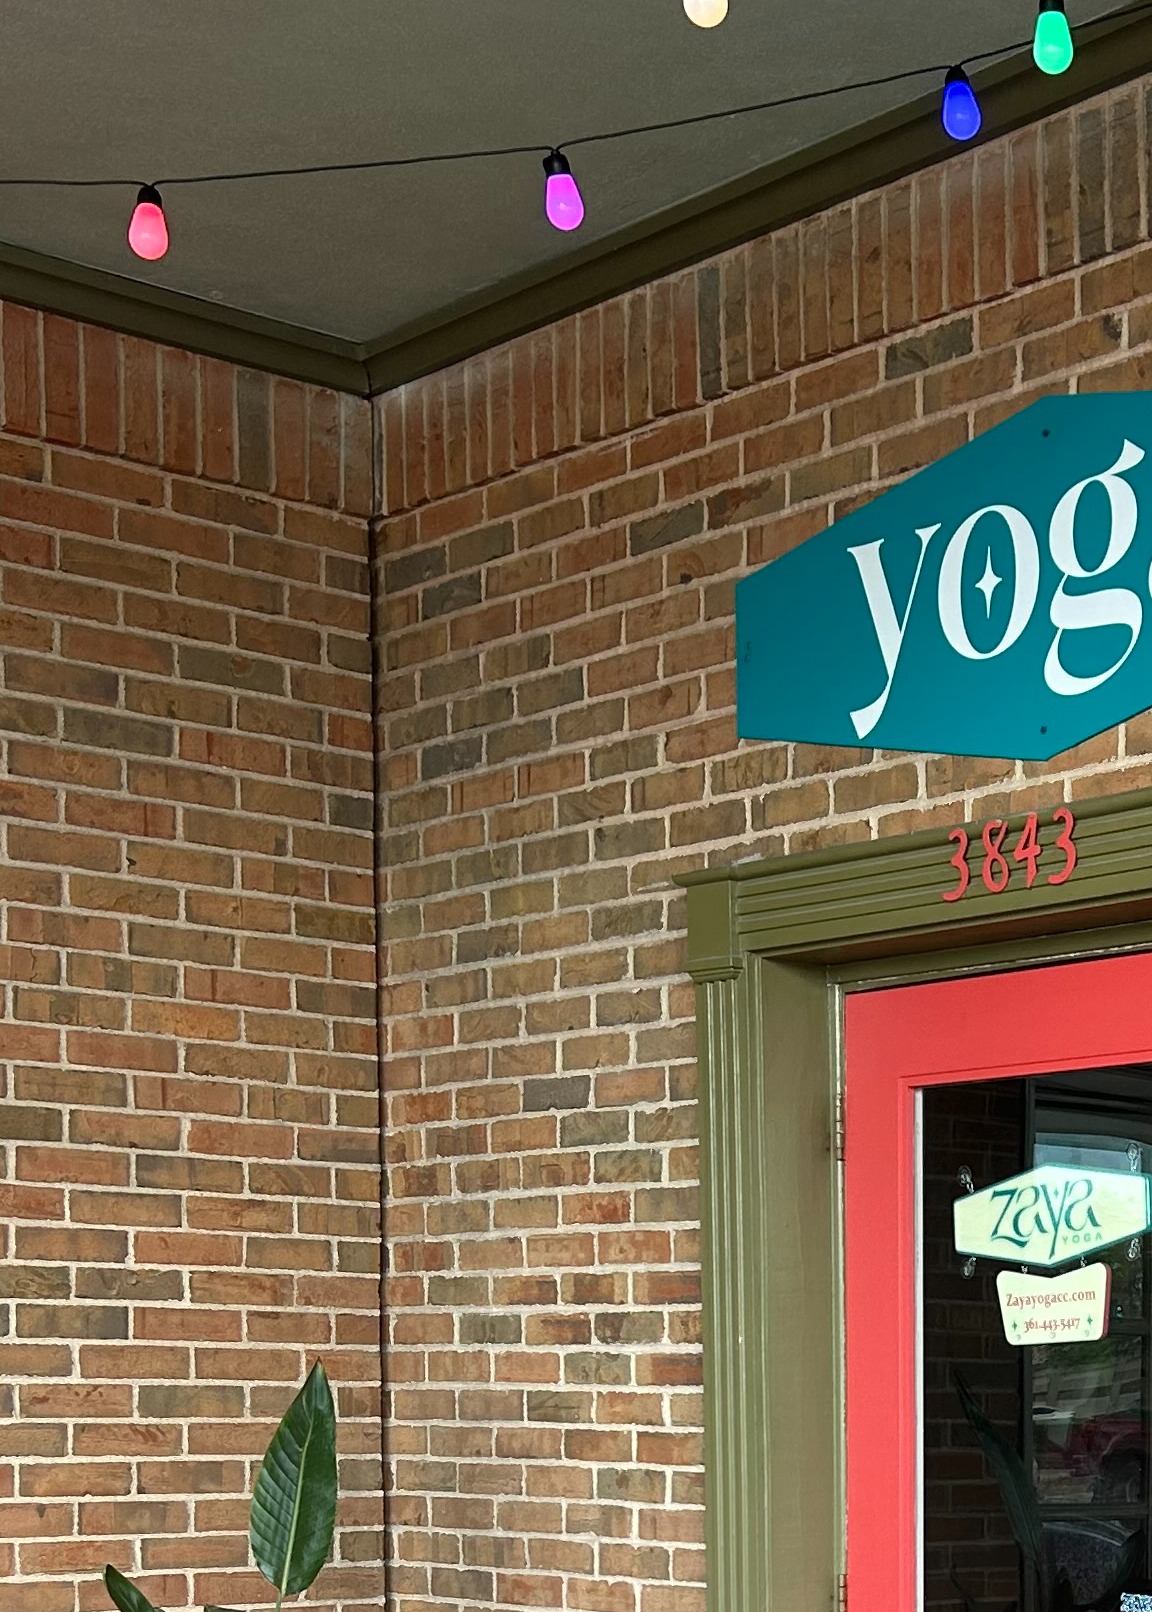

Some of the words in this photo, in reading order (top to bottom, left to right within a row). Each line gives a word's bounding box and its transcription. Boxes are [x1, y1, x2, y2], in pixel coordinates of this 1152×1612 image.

[942, 807, 1077, 901] 3843
[1062, 1232, 1103, 1245] YOGA
[1006, 1291, 1096, 1310] Zayayogacc.com
